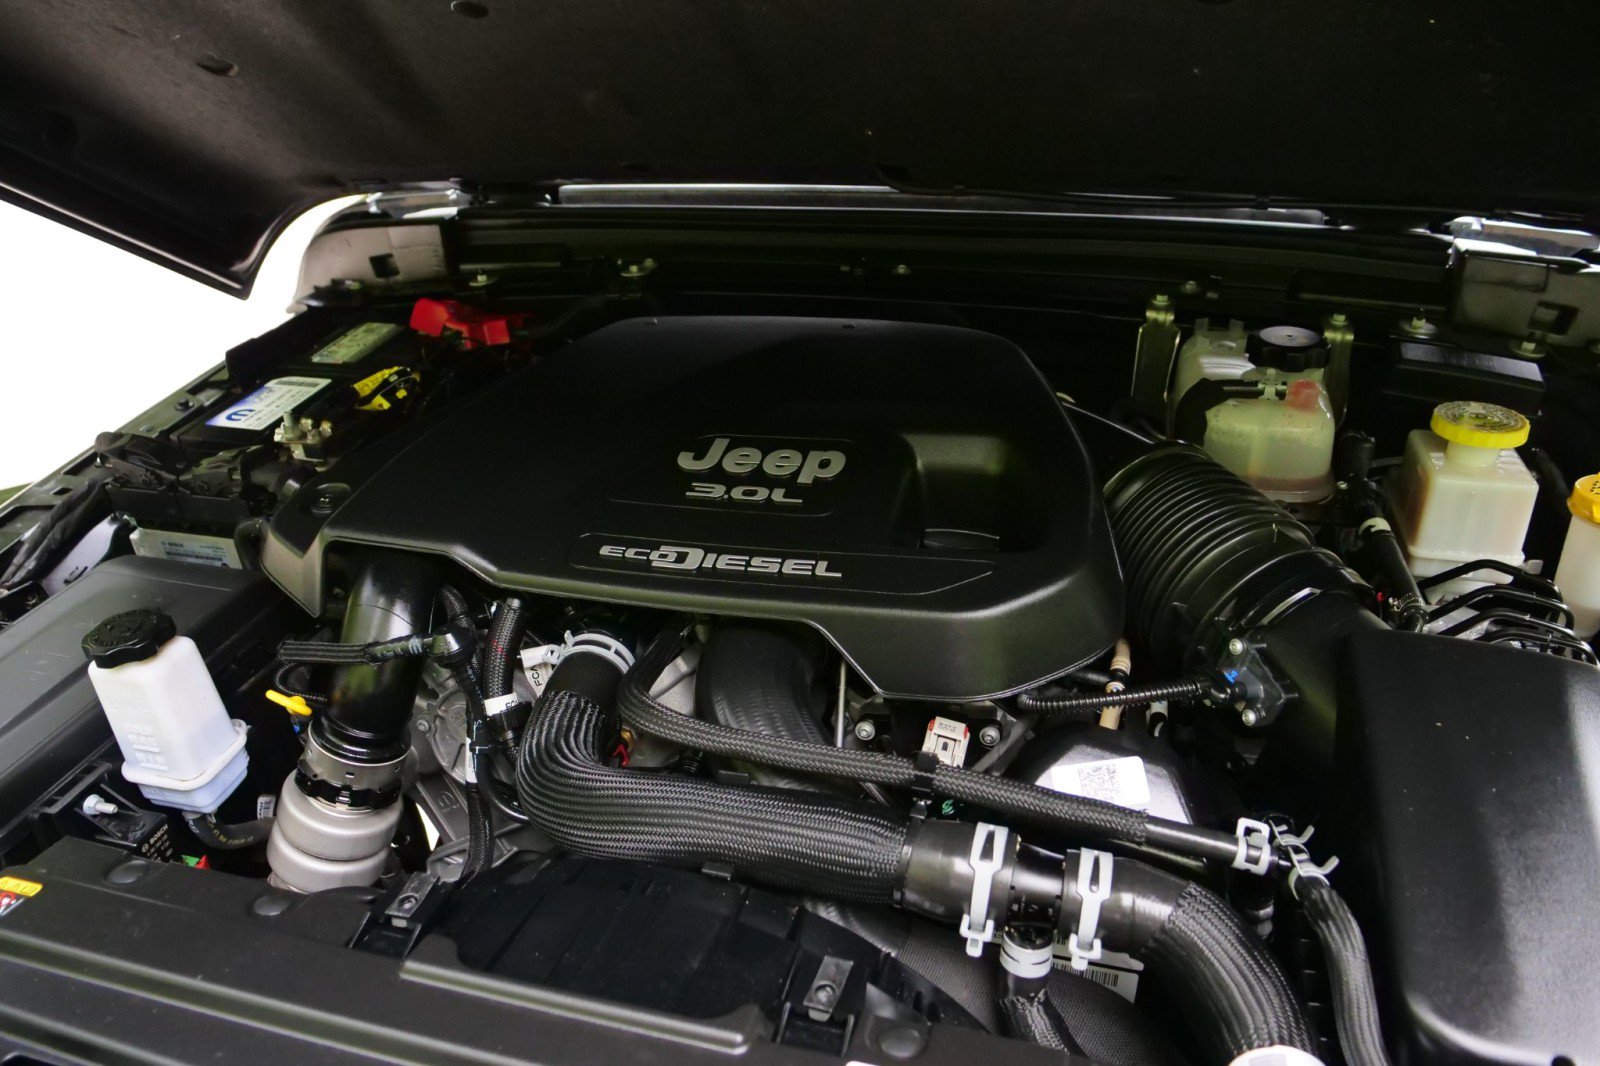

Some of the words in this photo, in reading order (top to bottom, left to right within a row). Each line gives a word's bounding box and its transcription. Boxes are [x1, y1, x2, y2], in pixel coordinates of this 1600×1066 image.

[677, 438, 846, 484] Jeep
[685, 482, 803, 503] 3.0L
[505, 700, 518, 709] FC
